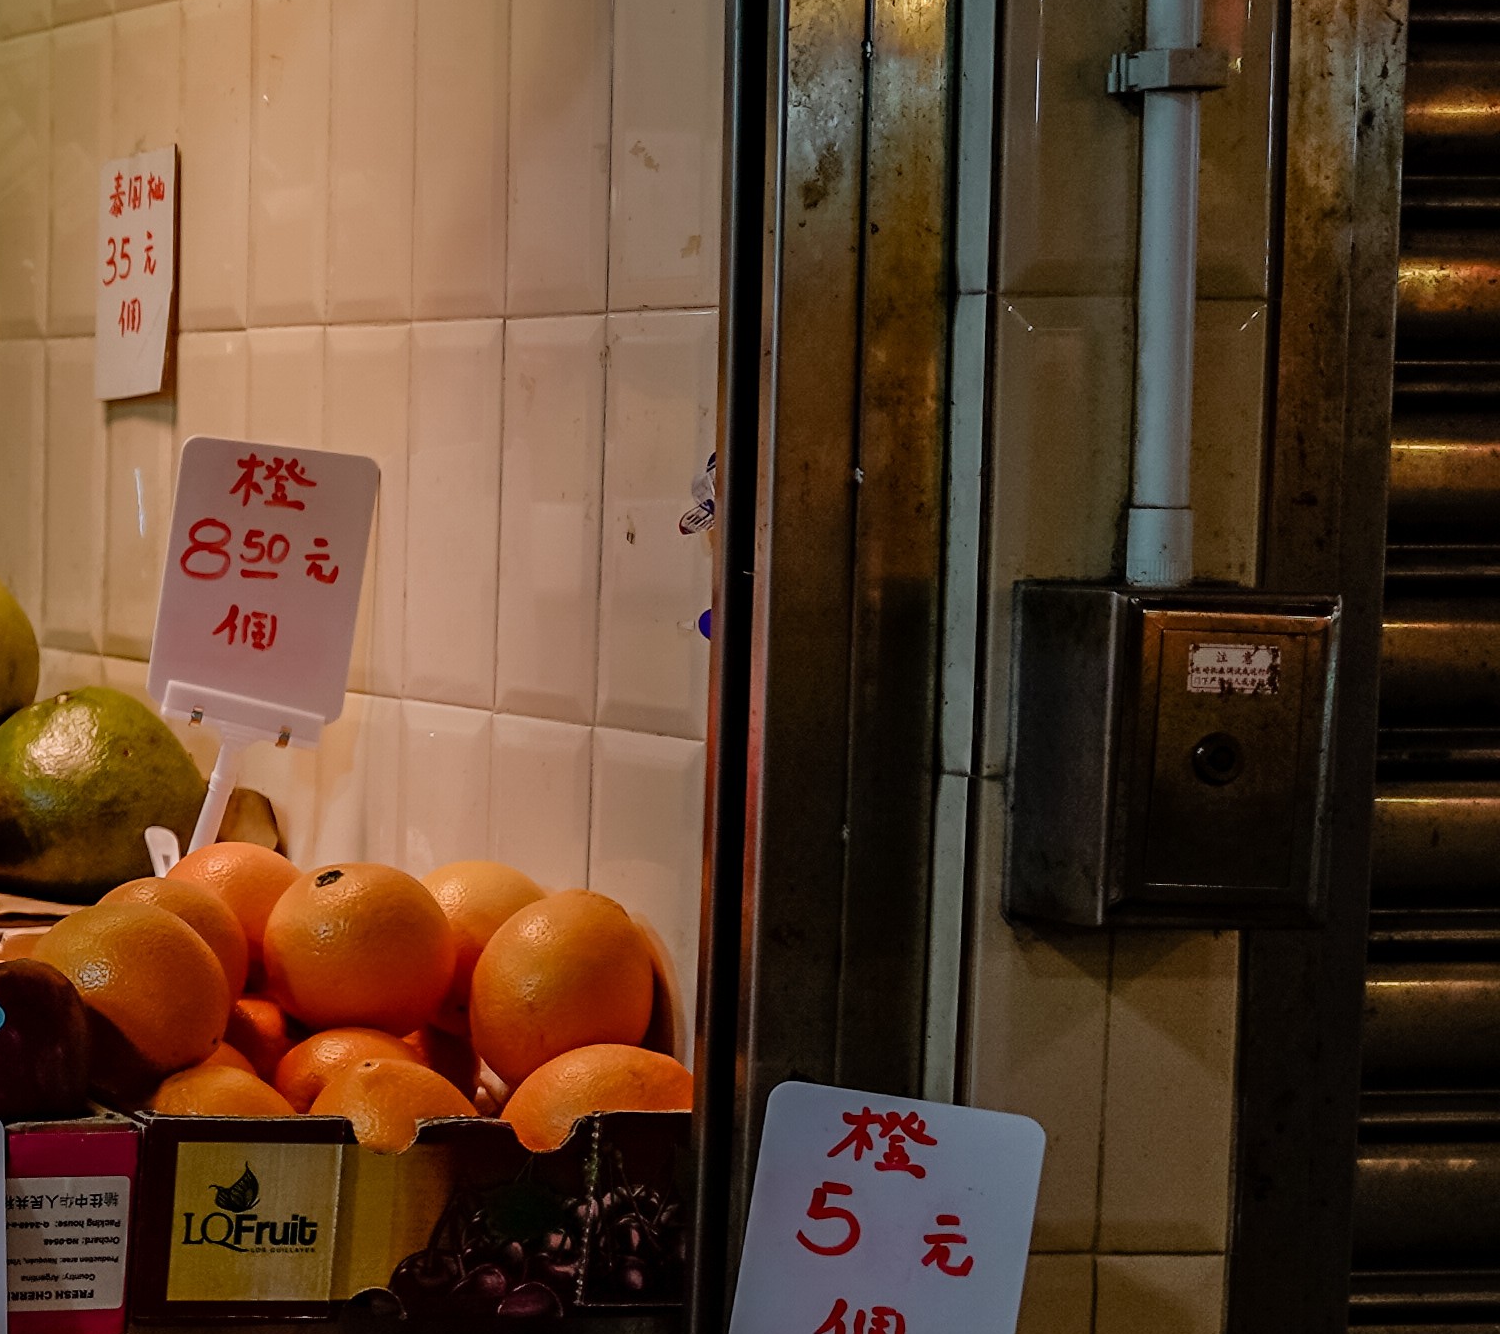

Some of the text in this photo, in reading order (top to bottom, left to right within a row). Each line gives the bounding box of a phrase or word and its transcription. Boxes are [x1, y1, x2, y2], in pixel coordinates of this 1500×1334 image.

[103, 231, 157, 287] 35 元
[230, 453, 317, 511] 橙
[304, 537, 340, 585] 元
[211, 605, 278, 651] 個
[827, 1106, 938, 1179] 橙
[182, 1209, 319, 1253] LQFruit
[796, 1181, 974, 1277] 5 元
[55, 1289, 94, 1300] FRESH
